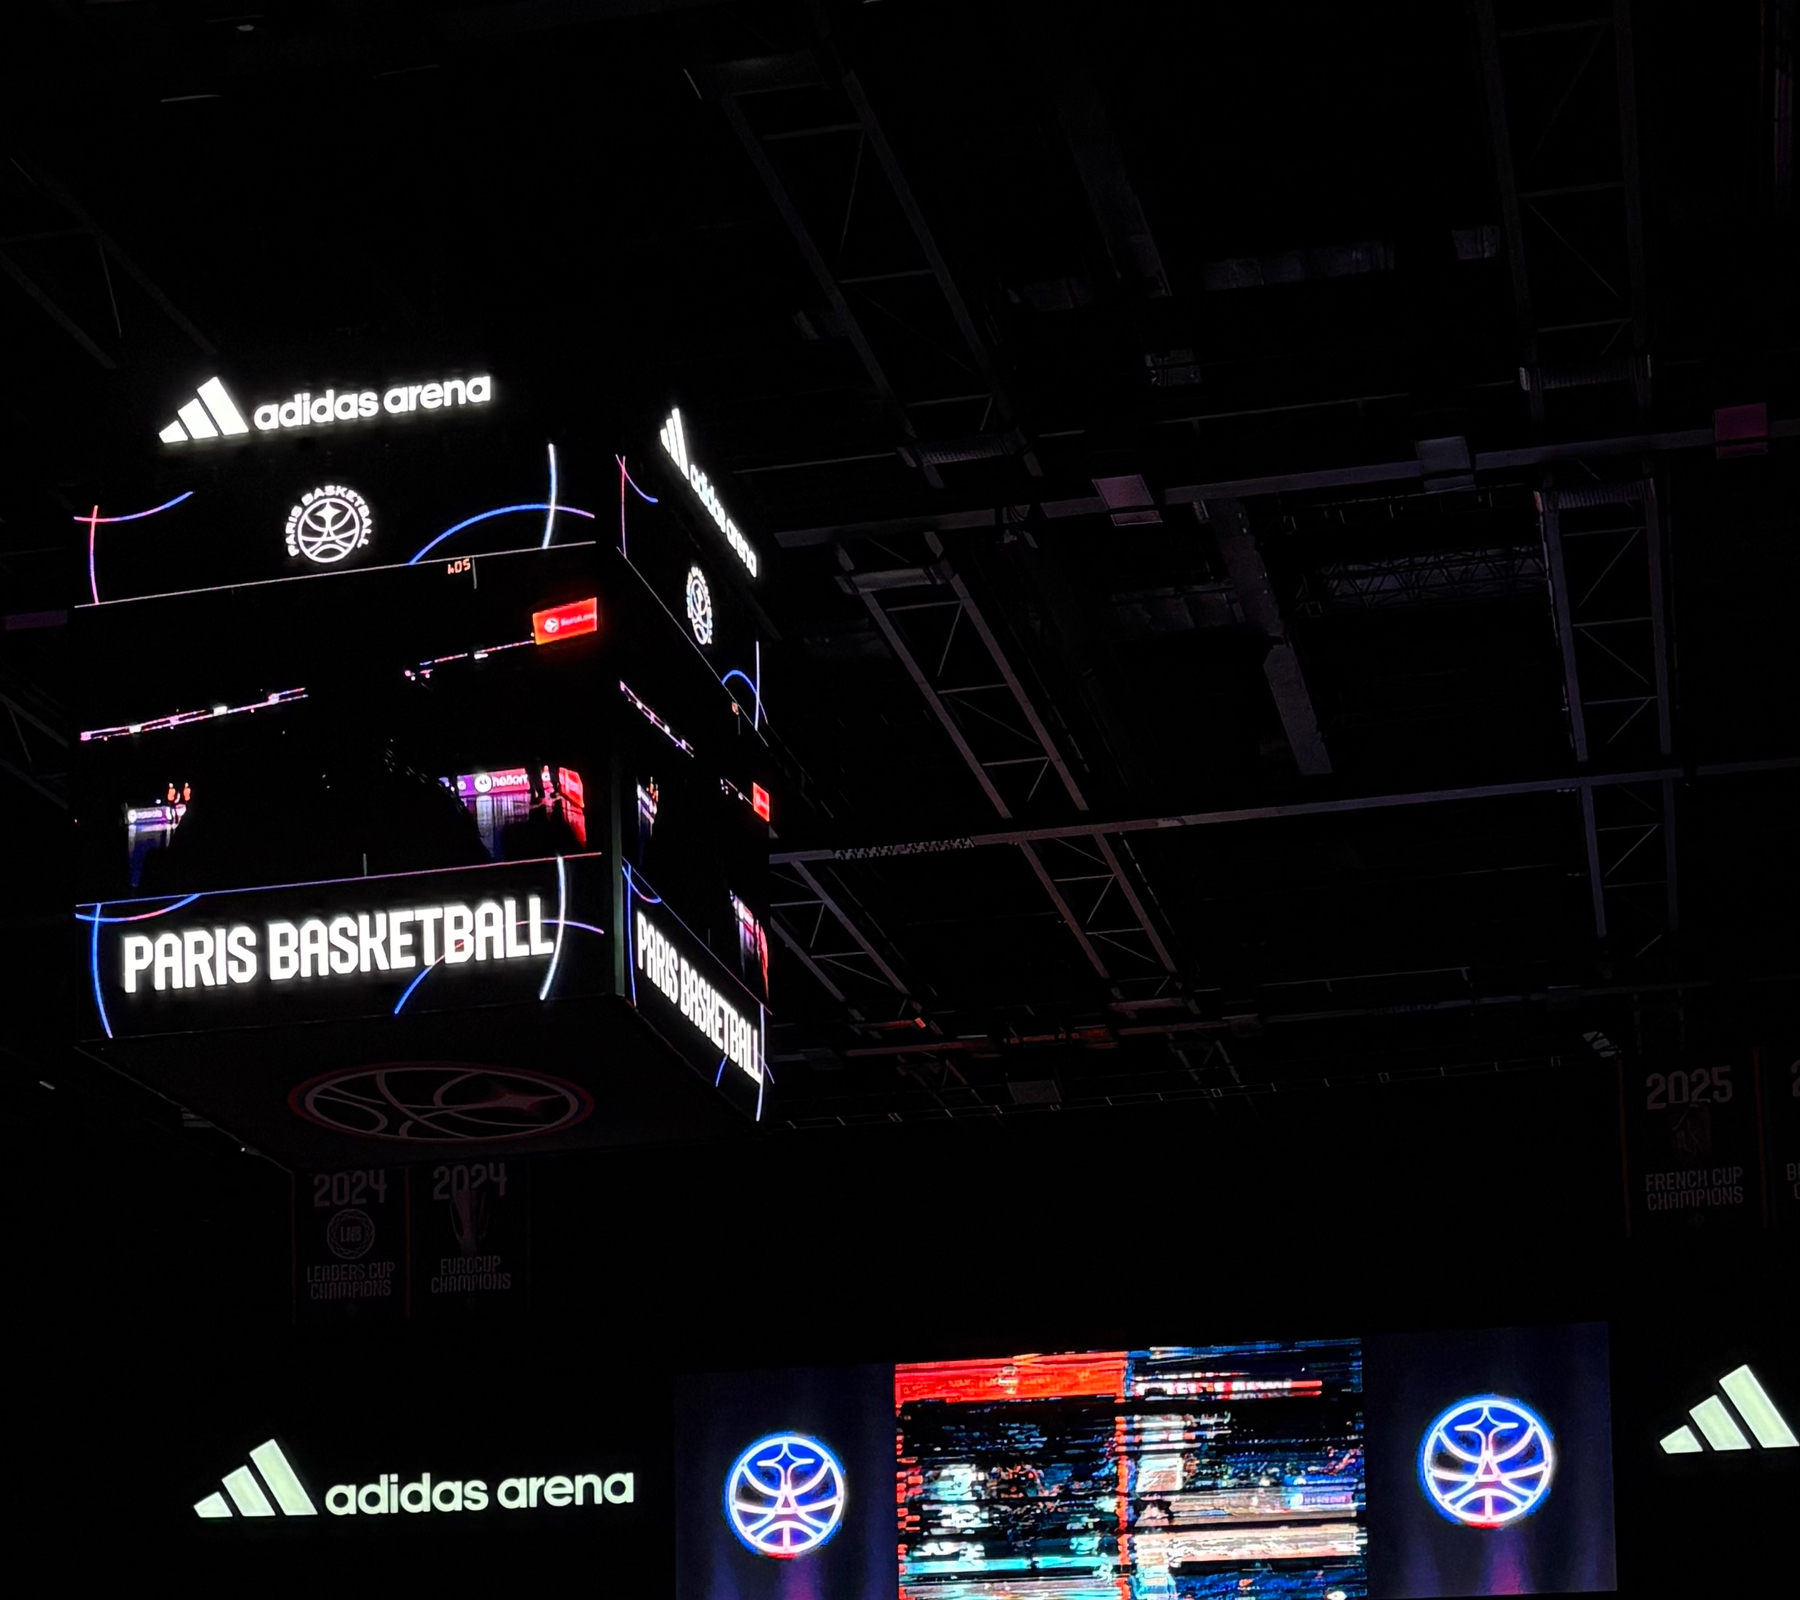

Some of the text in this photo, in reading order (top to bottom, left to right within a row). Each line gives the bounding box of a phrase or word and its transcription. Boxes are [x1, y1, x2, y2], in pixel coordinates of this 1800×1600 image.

[253, 375, 492, 431] adidas arena
[285, 485, 372, 557] PARIS BASKETBALL
[690, 463, 726, 533] adidas
[726, 518, 757, 578] arena
[123, 896, 555, 993] PARIS BASKETBALL
[636, 910, 763, 1084] PARIS BASKETBALL
[1645, 1065, 1733, 1110] 2025
[313, 1169, 388, 1207] 2024
[433, 1162, 508, 1201] 2024
[1645, 1165, 1743, 1193] FRENCH CUP
[1646, 1186, 1744, 1211] CHAMPIONS
[306, 1261, 396, 1284] LEADERS CUP
[430, 1273, 512, 1294] CHAMPIONS
[440, 1255, 501, 1275] EUROCUP
[310, 1279, 392, 1300] CHAMPIONS
[325, 1472, 634, 1516] adidas arena
